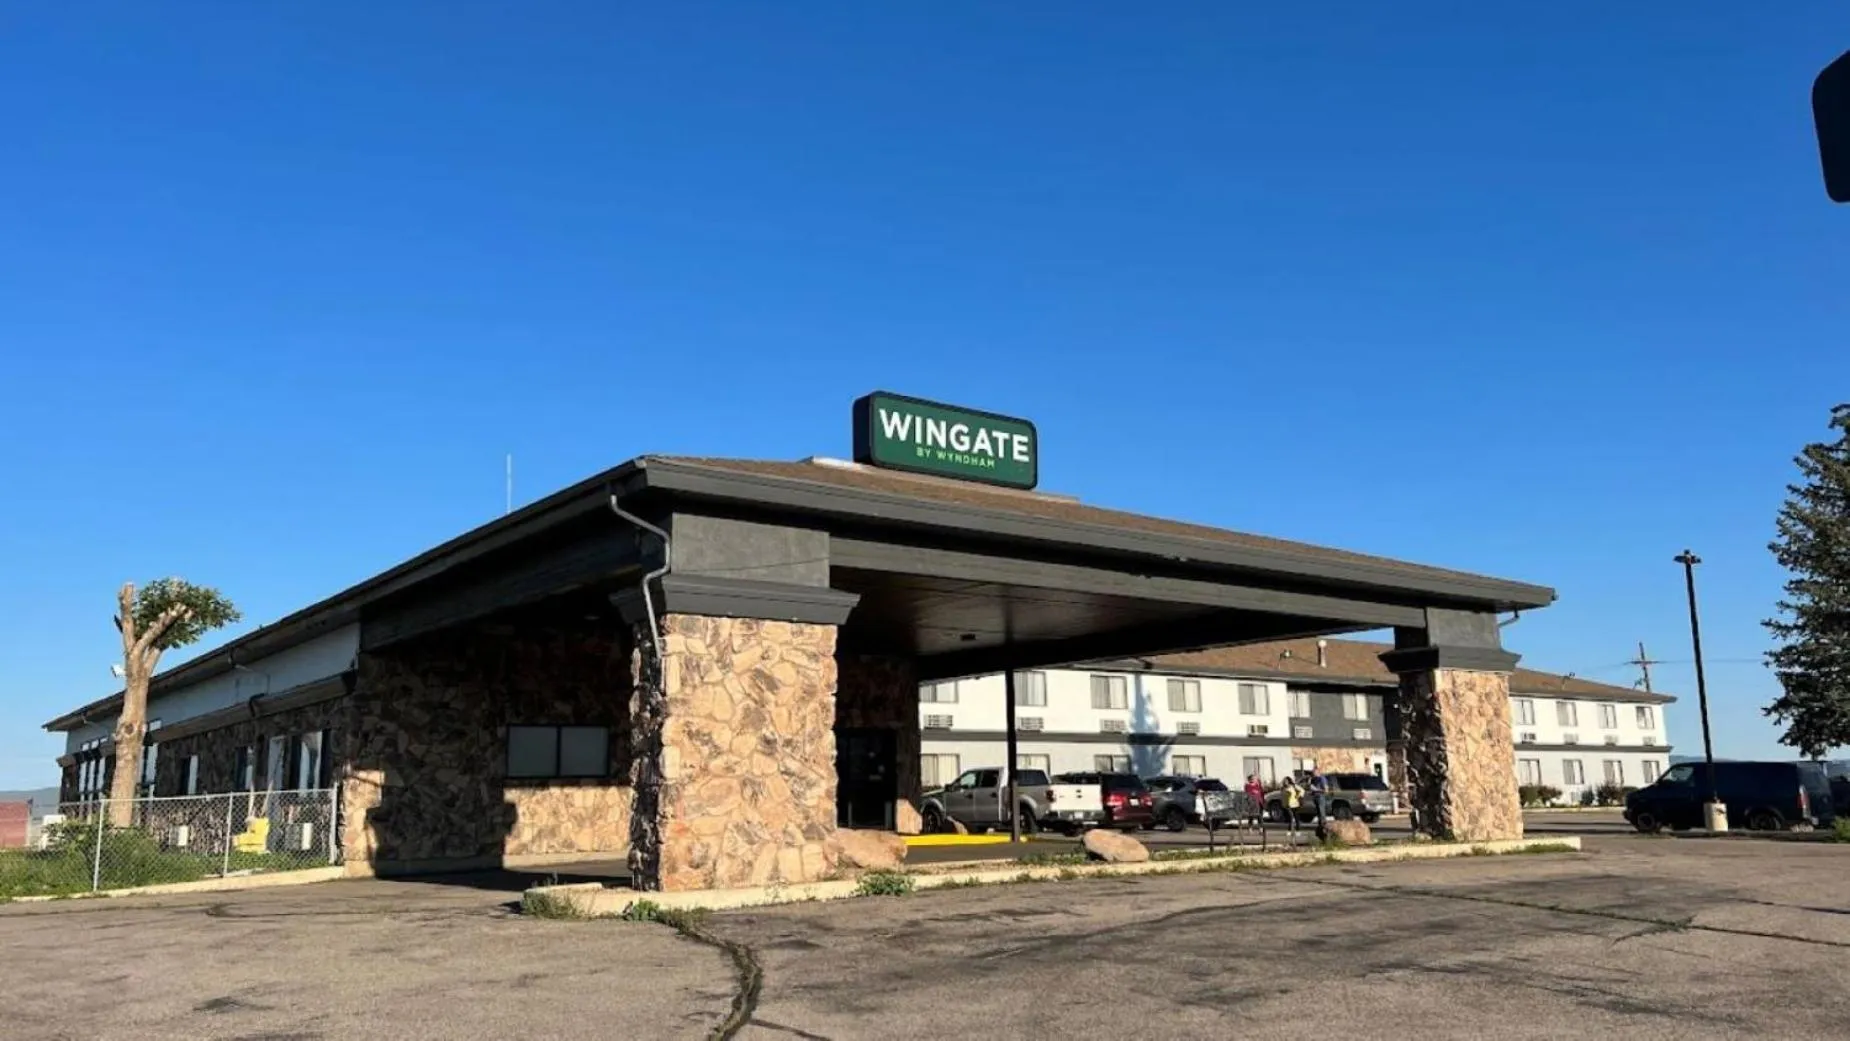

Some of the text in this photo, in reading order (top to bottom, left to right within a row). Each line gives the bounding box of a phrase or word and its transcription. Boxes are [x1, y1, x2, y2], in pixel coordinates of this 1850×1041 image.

[879, 408, 1030, 462] WINGATE
[916, 448, 995, 468] BY WYNDHAM
